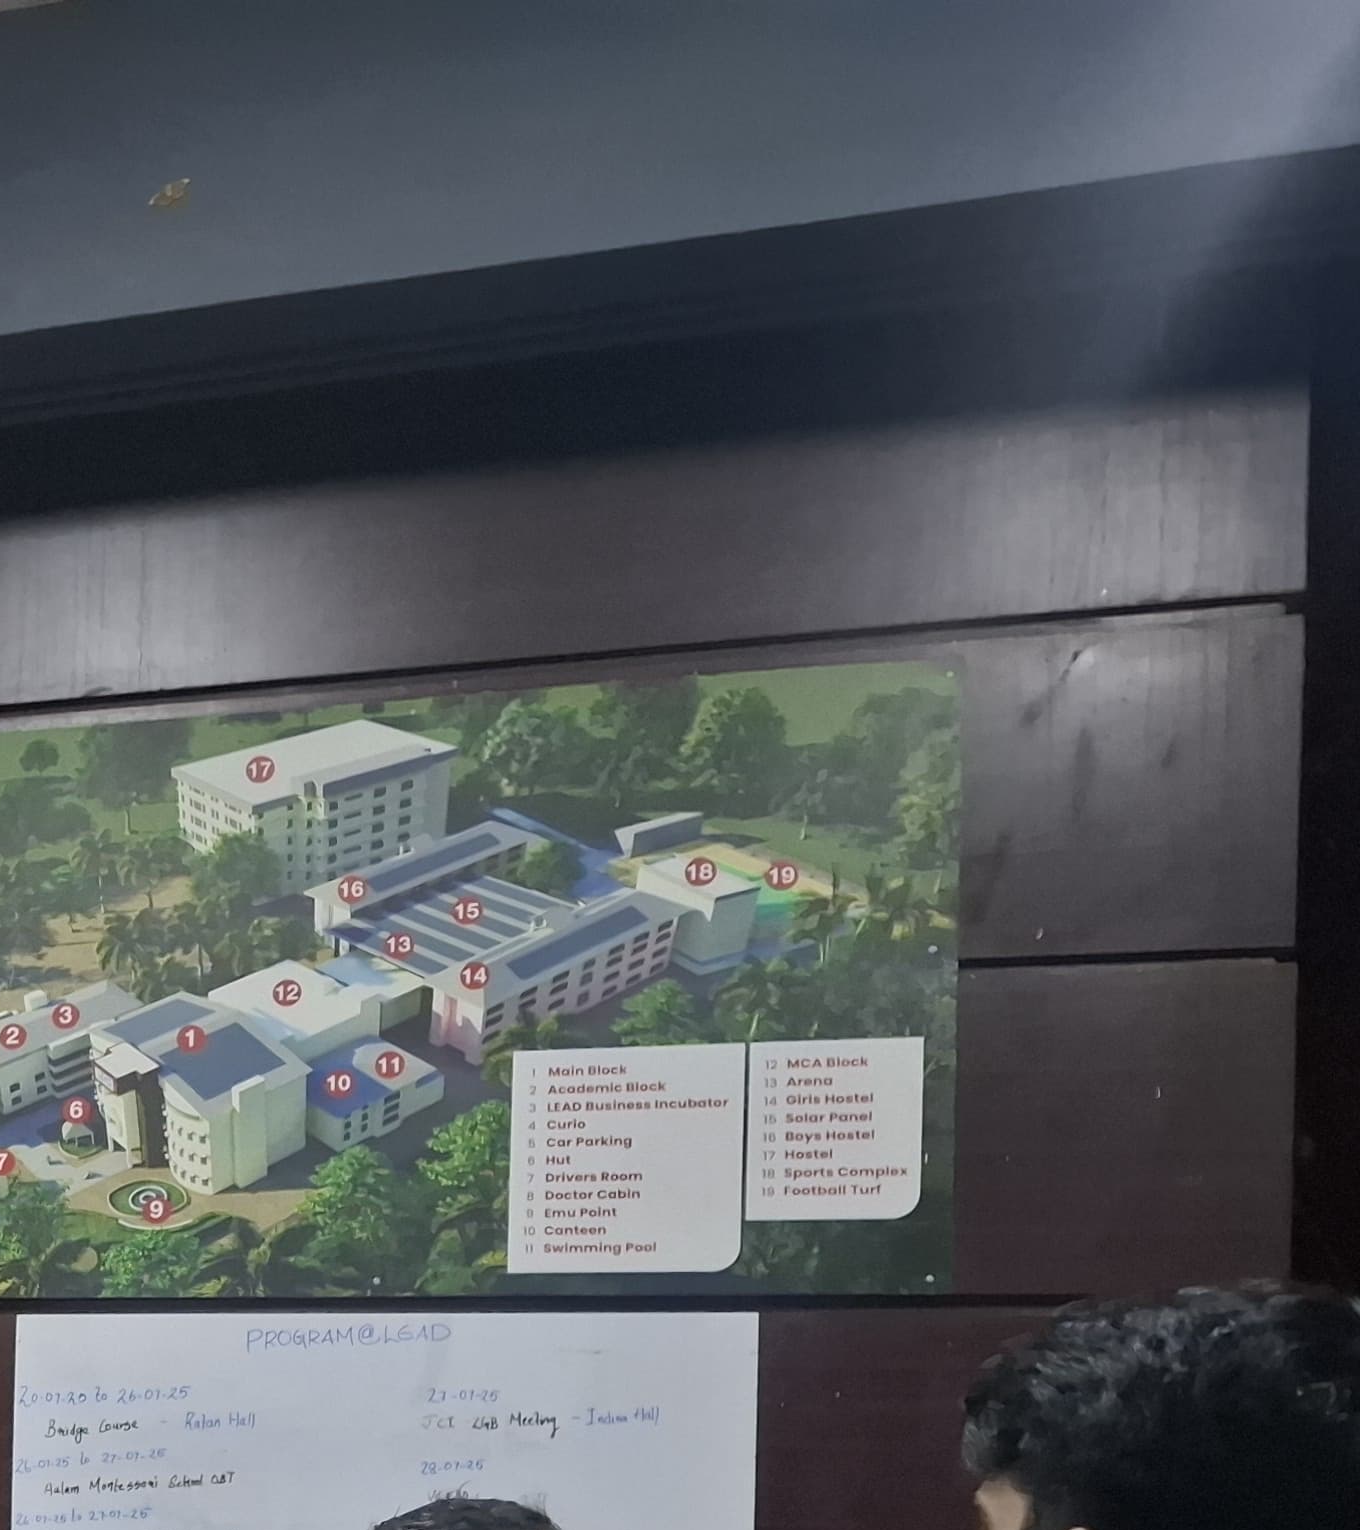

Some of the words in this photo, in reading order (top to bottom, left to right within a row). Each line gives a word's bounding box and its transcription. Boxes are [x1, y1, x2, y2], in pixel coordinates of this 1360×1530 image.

[250, 762, 271, 778] 17
[687, 865, 712, 880] 18
[770, 867, 793, 884] 19
[340, 881, 362, 898] 16
[455, 902, 478, 920] 15
[387, 937, 410, 952] 13
[462, 967, 485, 985] 14
[276, 985, 298, 1001] 12
[60, 1006, 72, 1023] 3
[3, 1025, 19, 1044] 2
[185, 1030, 195, 1047] 1
[379, 1058, 400, 1073] 11
[532, 1067, 536, 1078] 1
[548, 1065, 584, 1077] Main
[587, 1064, 627, 1076] Block
[765, 1059, 778, 1071] 12
[786, 1058, 822, 1069] MCA
[826, 1056, 868, 1068] Block
[328, 1075, 350, 1090] 10
[529, 1085, 537, 1096] 2
[547, 1082, 622, 1095] Academic
[625, 1080, 666, 1093] Block
[764, 1077, 778, 1089] 13
[786, 1076, 833, 1087] Arena
[528, 1102, 537, 1114] 3
[547, 1101, 582, 1113] LEAD
[585, 1099, 651, 1112] Business
[654, 1098, 728, 1109] Incubator
[764, 1095, 777, 1107] 14
[785, 1093, 821, 1105] Girls
[824, 1092, 874, 1105] Hostel
[70, 1101, 82, 1118] 6
[527, 1120, 536, 1131] 4
[546, 1118, 586, 1130] Curio
[763, 1113, 777, 1125] 15
[785, 1112, 825, 1124] Solar
[829, 1111, 873, 1123] Panel
[527, 1137, 536, 1149] 5
[546, 1137, 572, 1148] Car
[575, 1135, 633, 1149] Parking
[762, 1132, 777, 1143] 16
[785, 1131, 822, 1145] Boys
[825, 1129, 875, 1141] Hostel
[527, 1155, 536, 1167] 6
[545, 1155, 571, 1166] Hut
[762, 1150, 777, 1161] 17
[784, 1148, 833, 1160] Hostel
[527, 1172, 535, 1184] 7
[545, 1171, 597, 1183] Drivers
[600, 1171, 643, 1182] Room
[761, 1168, 776, 1179] 18
[784, 1167, 834, 1181] Sports
[837, 1165, 907, 1180] Complex
[526, 1191, 535, 1202] 8
[544, 1190, 594, 1201] Doctor
[596, 1188, 641, 1200] Cabin
[761, 1185, 776, 1198] 19
[783, 1184, 847, 1196] Football
[850, 1184, 881, 1195] Turf
[150, 1201, 163, 1218] 9
[525, 1208, 534, 1219] 9
[544, 1208, 576, 1219] Emu
[579, 1206, 617, 1218] Point
[523, 1225, 536, 1236] 10
[544, 1225, 607, 1236] Canteen
[525, 1243, 534, 1254] 11
[543, 1241, 622, 1256] Swimming
[625, 1241, 657, 1253] Pool
[246, 1323, 452, 1352] PROGRAM@LEAD
[96, 1386, 107, 1402] to
[45, 1419, 89, 1443] Bridge
[99, 1419, 139, 1434] Course
[229, 1412, 256, 1429] Hall
[510, 1412, 559, 1438] Meeting
